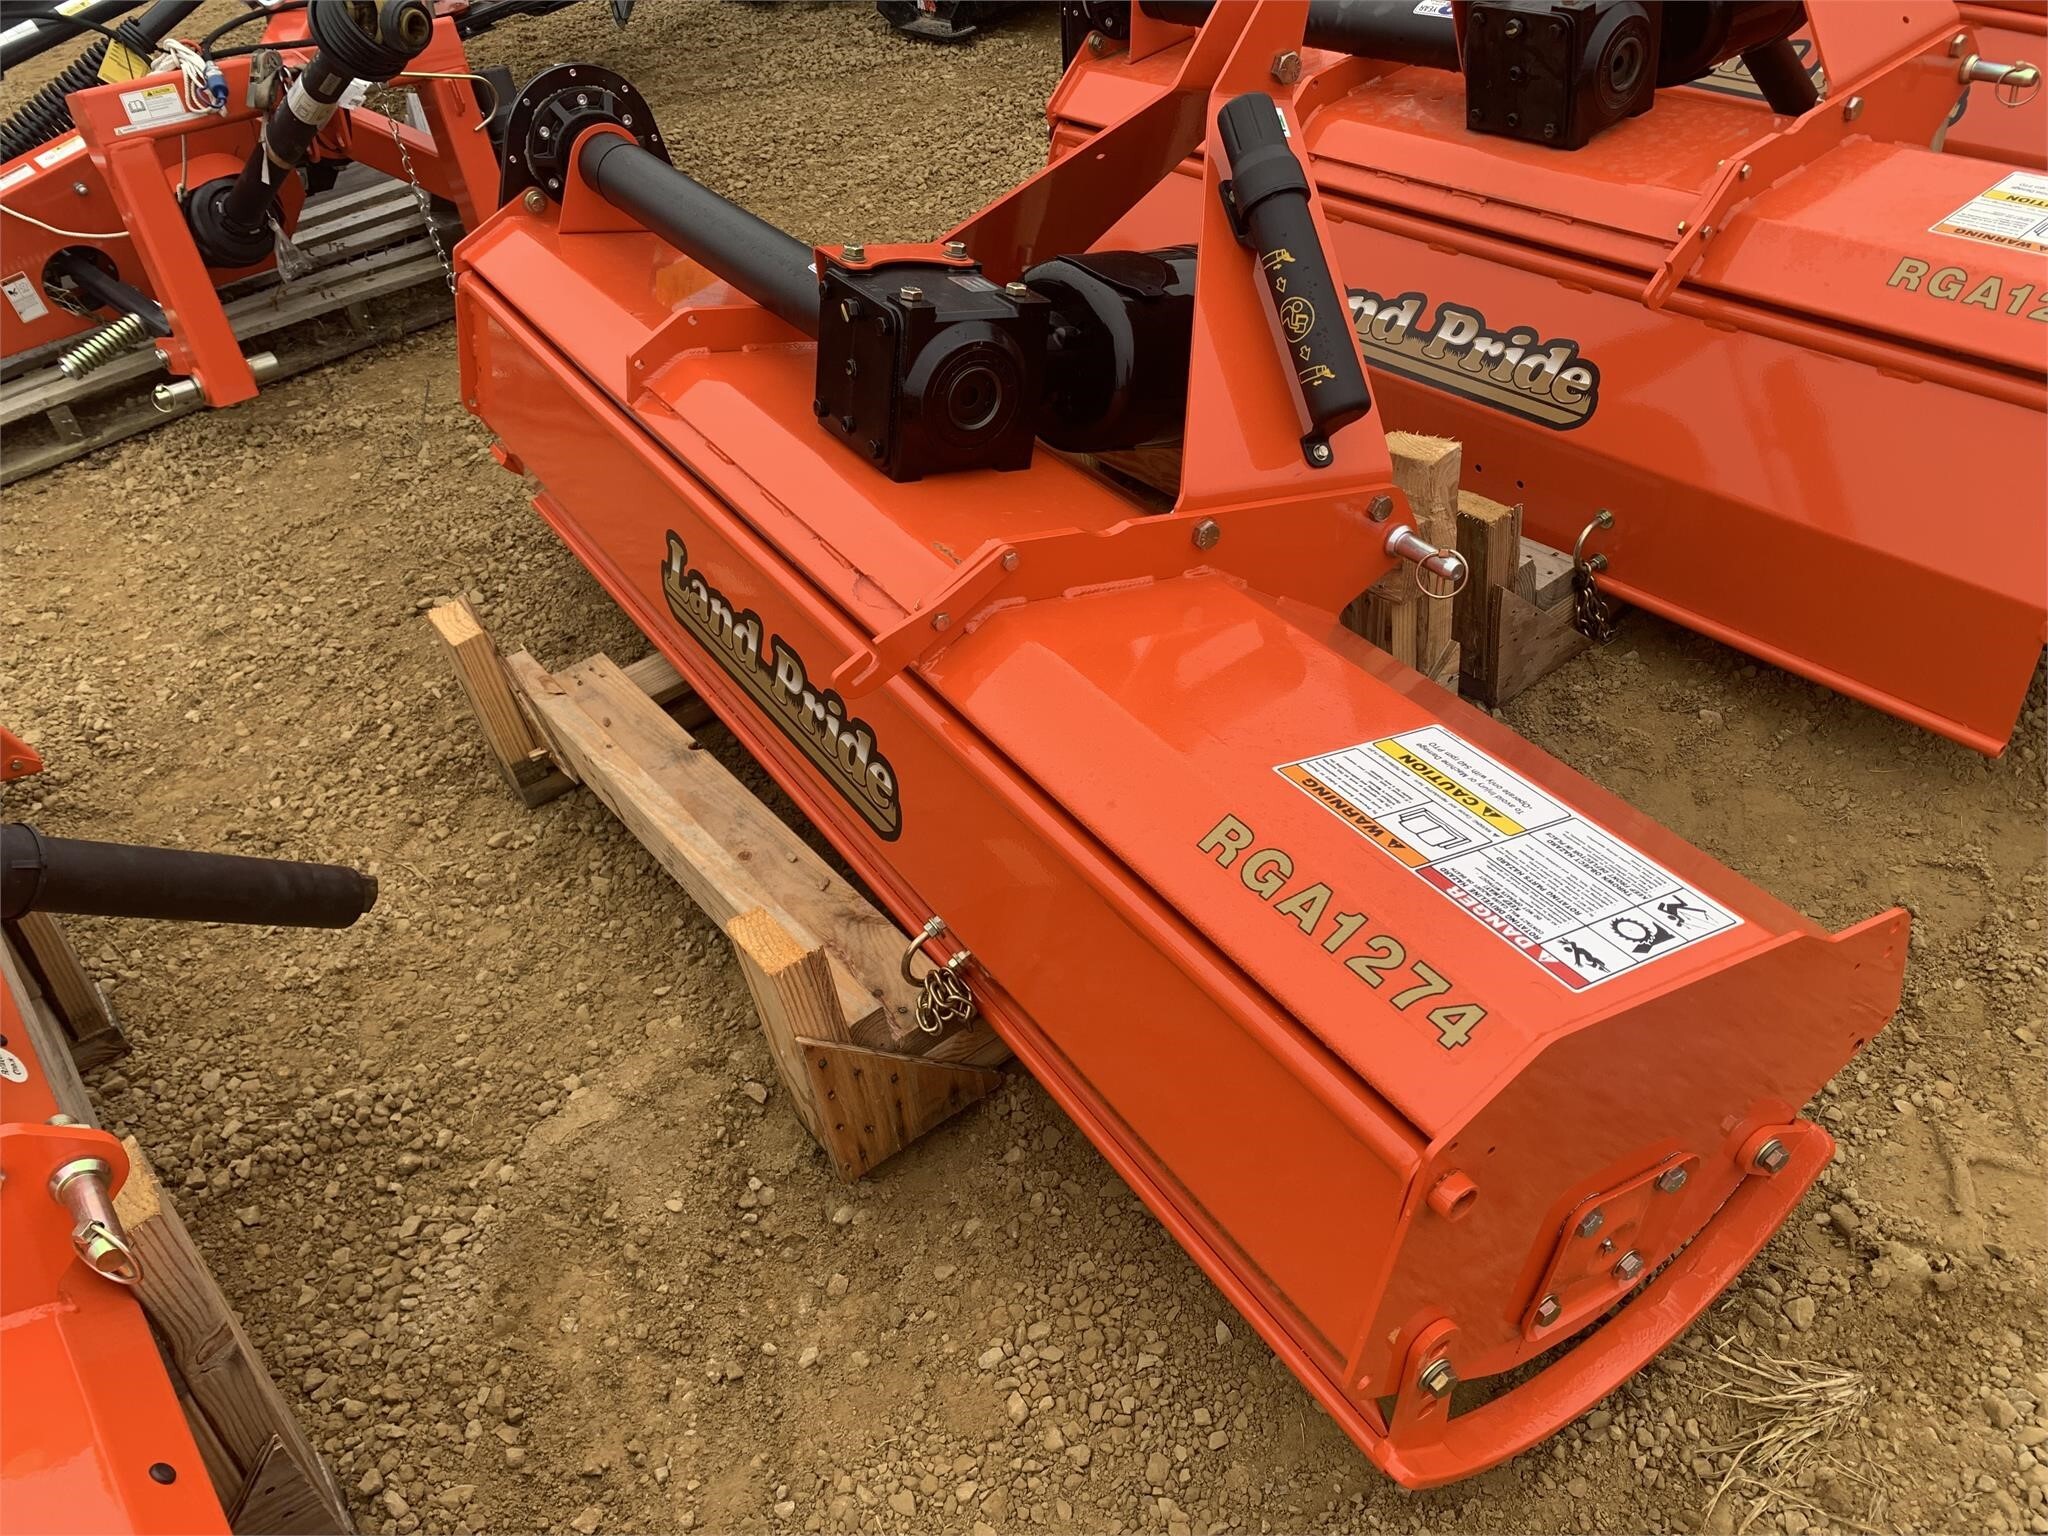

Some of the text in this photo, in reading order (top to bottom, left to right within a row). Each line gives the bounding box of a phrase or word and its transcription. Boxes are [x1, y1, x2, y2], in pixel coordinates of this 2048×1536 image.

[2006, 195, 2048, 207] TION
[1954, 228, 2032, 248] WARNING
[1886, 256, 2048, 323] RGA12
[1347, 295, 1593, 404] nd Pride
[664, 537, 894, 809] Land Pride
[1413, 742, 1444, 759] Damage
[1427, 741, 1447, 751] PTO
[1442, 751, 1461, 761] rpm
[1439, 759, 1470, 777] Machine
[1468, 768, 1488, 779] with
[1397, 754, 1481, 806] CAUTION
[1473, 782, 1498, 795] Injury
[1483, 778, 1505, 789] only
[1299, 777, 1387, 836] WARNING
[1492, 794, 1517, 808] avoid
[1545, 839, 1633, 896] THROWN OBJECT HAZARD
[1494, 856, 1582, 915] ROTATING PARTS HAZARD
[1628, 887, 1649, 900] KEEP
[1438, 867, 1542, 940] ROTATING DRIVELINE HAZARD
[1443, 885, 1535, 948] DANGER
[1196, 813, 1488, 1051] RGA1274
